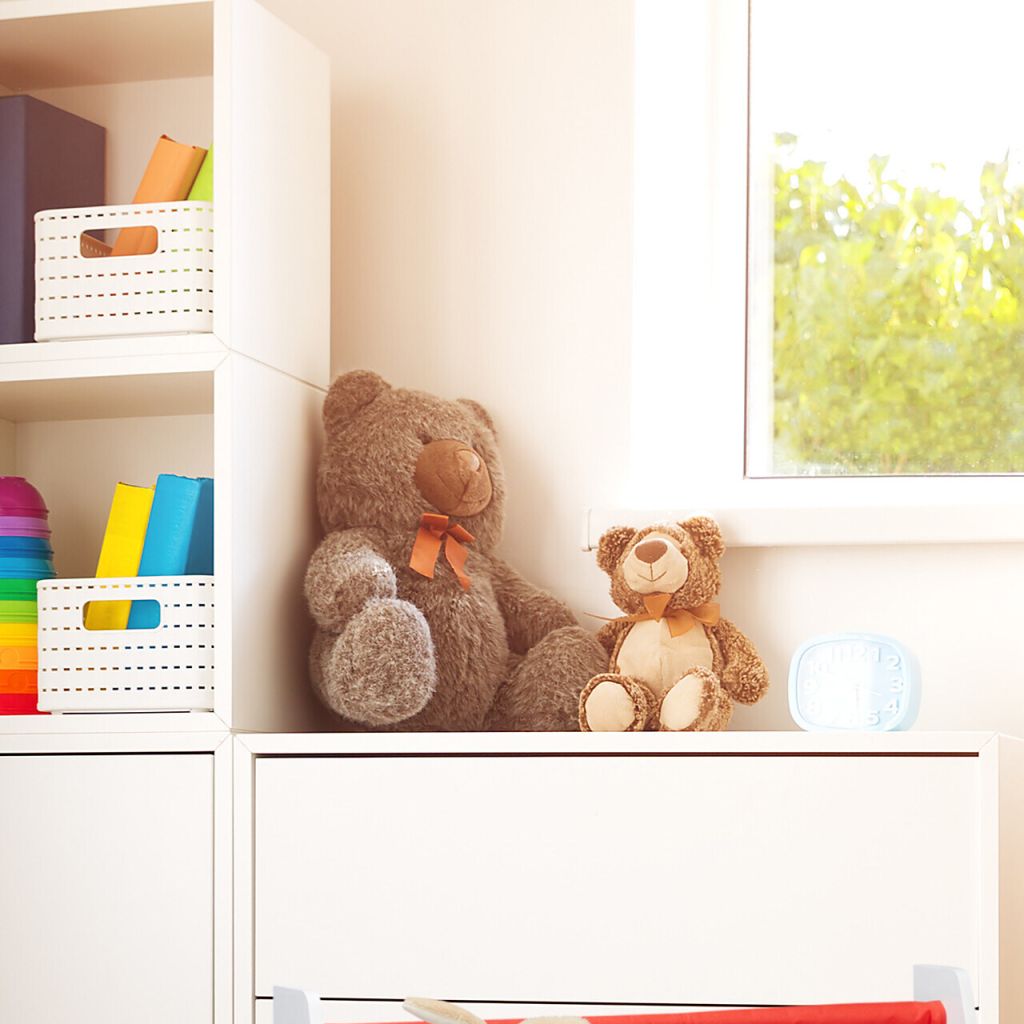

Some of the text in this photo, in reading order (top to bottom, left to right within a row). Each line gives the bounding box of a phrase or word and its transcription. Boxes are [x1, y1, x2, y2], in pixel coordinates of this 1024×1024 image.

[886, 655, 901, 671] 2
[890, 676, 904, 693] 3
[866, 710, 881, 726] 5
